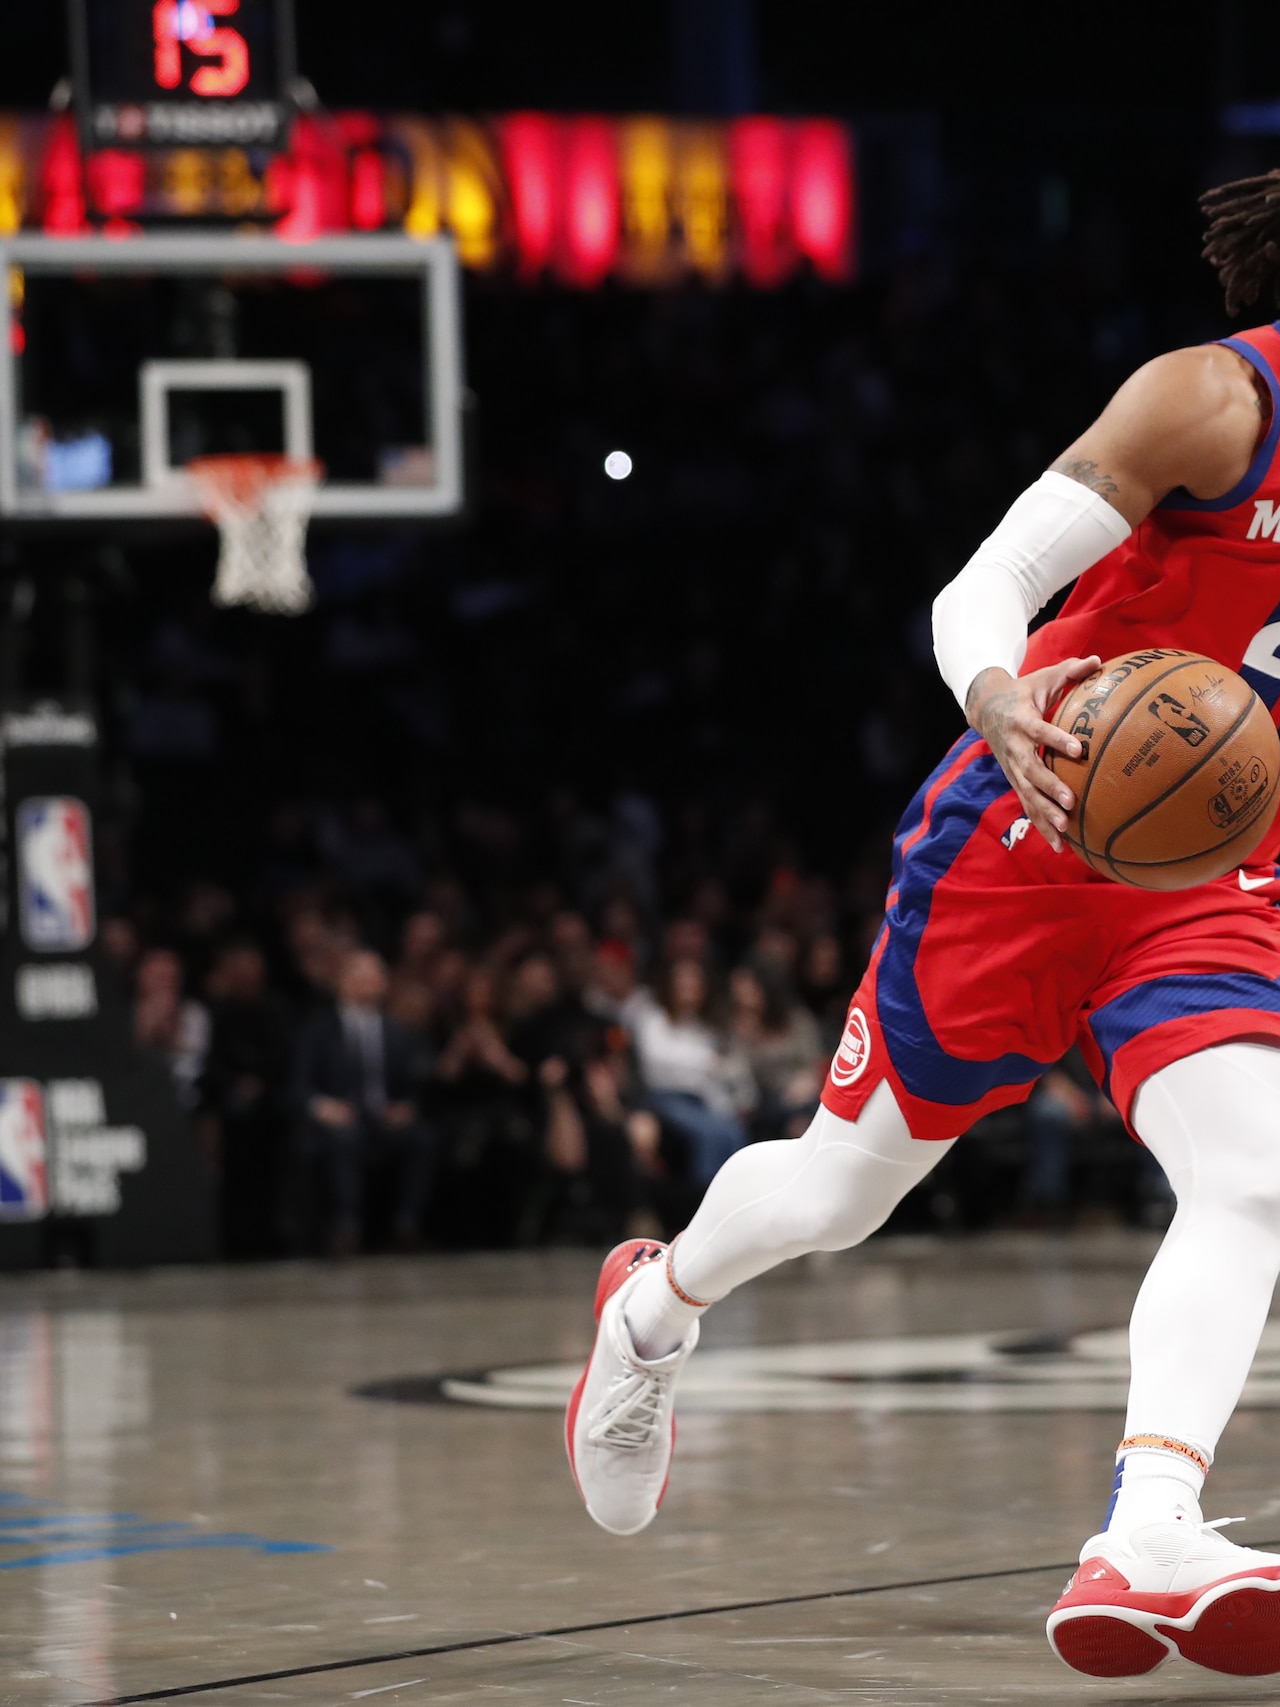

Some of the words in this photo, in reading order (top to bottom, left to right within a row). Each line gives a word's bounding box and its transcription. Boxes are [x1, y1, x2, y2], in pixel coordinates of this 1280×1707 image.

[153, 0, 249, 96] 15
[1122, 753, 1145, 777] OFFICIAL
[1139, 739, 1156, 757] GAME
[1150, 729, 1166, 744] BALL
